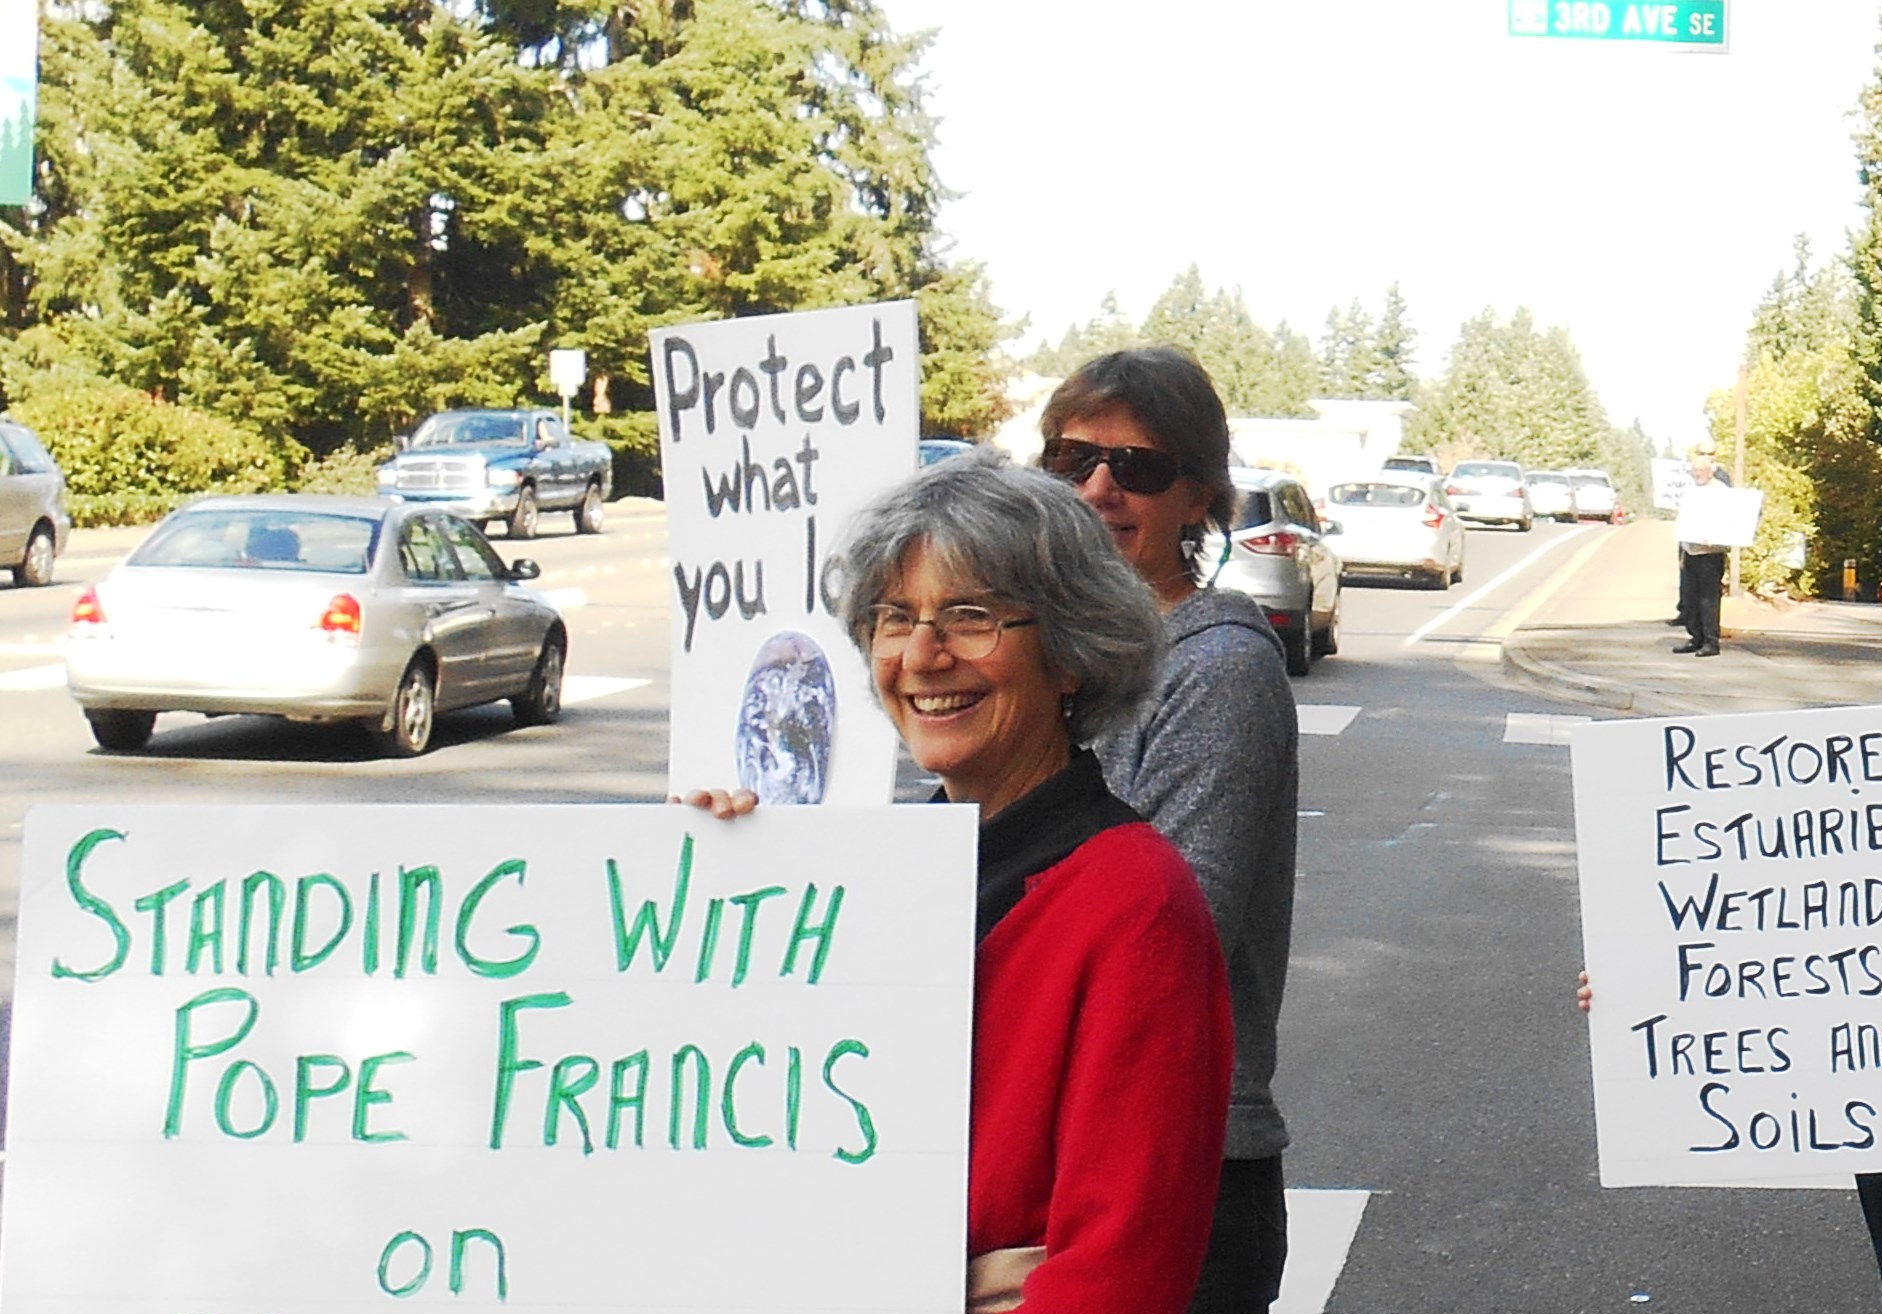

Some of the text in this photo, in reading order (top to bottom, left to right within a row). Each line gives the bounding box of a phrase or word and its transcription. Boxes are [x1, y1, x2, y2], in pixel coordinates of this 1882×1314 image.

[1553, 1, 1715, 35] 3RD AVE SE
[663, 317, 893, 442] Protect
[702, 432, 819, 518] what
[674, 558, 767, 653] you
[51, 828, 846, 988] STANDING WITH
[162, 987, 880, 1164] POPE FRANCIS
[1631, 1014, 1792, 1079] TREES
[377, 1228, 508, 1301] on
